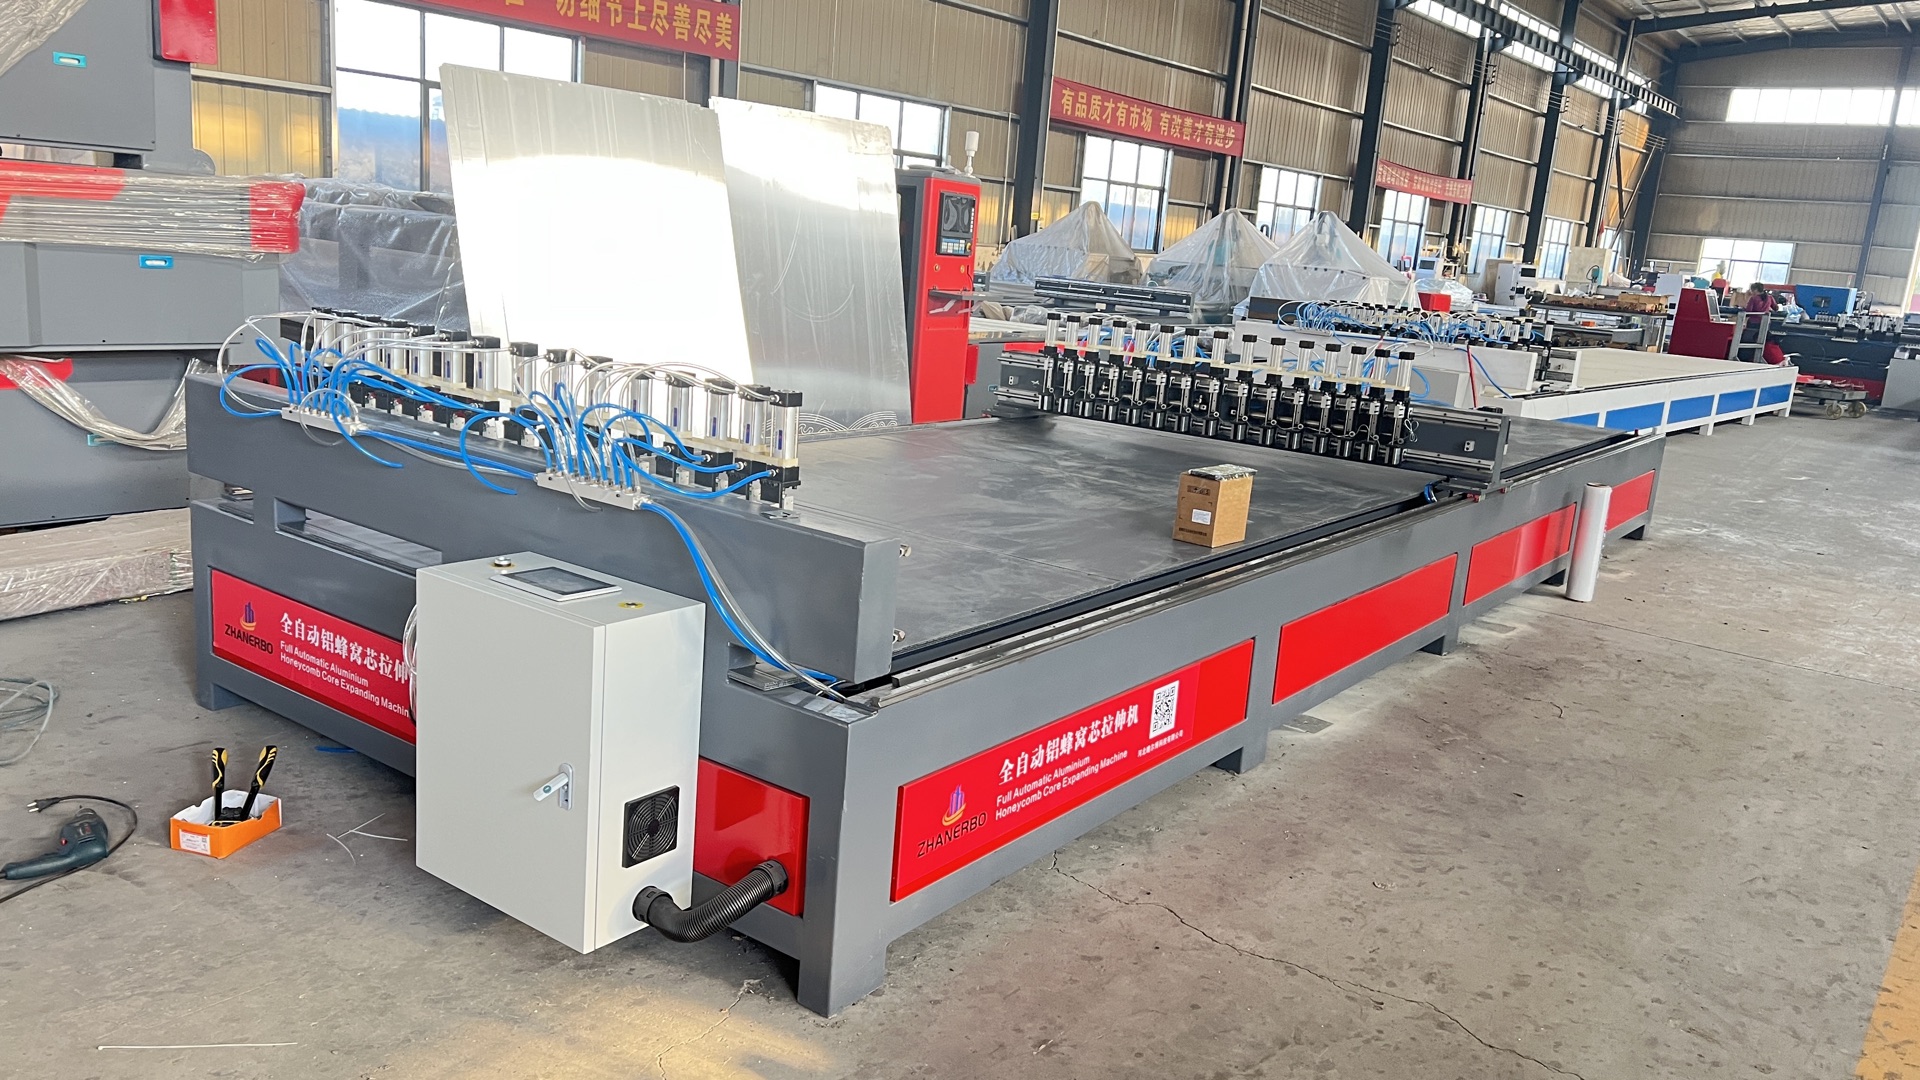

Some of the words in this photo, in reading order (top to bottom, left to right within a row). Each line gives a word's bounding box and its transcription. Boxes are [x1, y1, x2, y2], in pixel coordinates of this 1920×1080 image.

[1061, 87, 1153, 133] 有品质才有市场
[1159, 111, 1236, 149] 有改善才有进步
[224, 623, 274, 654] ZHANERBO
[280, 613, 408, 684] 全自动铝蜂窝芯拉伸
[280, 640, 294, 653] Full
[294, 646, 330, 671] Automatic
[330, 662, 369, 687] Aluminium
[280, 652, 321, 678] Honeycomb
[321, 671, 340, 687] Core
[340, 679, 380, 706] Expanding
[381, 696, 410, 718] Machin
[998, 704, 1139, 786] 全自动铝蜂窝芯拉伸机
[995, 792, 1043, 821] Honeycomb
[1042, 781, 1062, 797] Core
[1062, 763, 1099, 788] Expanding
[1099, 750, 1128, 770] Machine
[996, 790, 1013, 808] Full
[1012, 774, 1052, 800] Automatic
[1052, 755, 1091, 780] Aluminium
[917, 812, 987, 858] ZHANERBO
